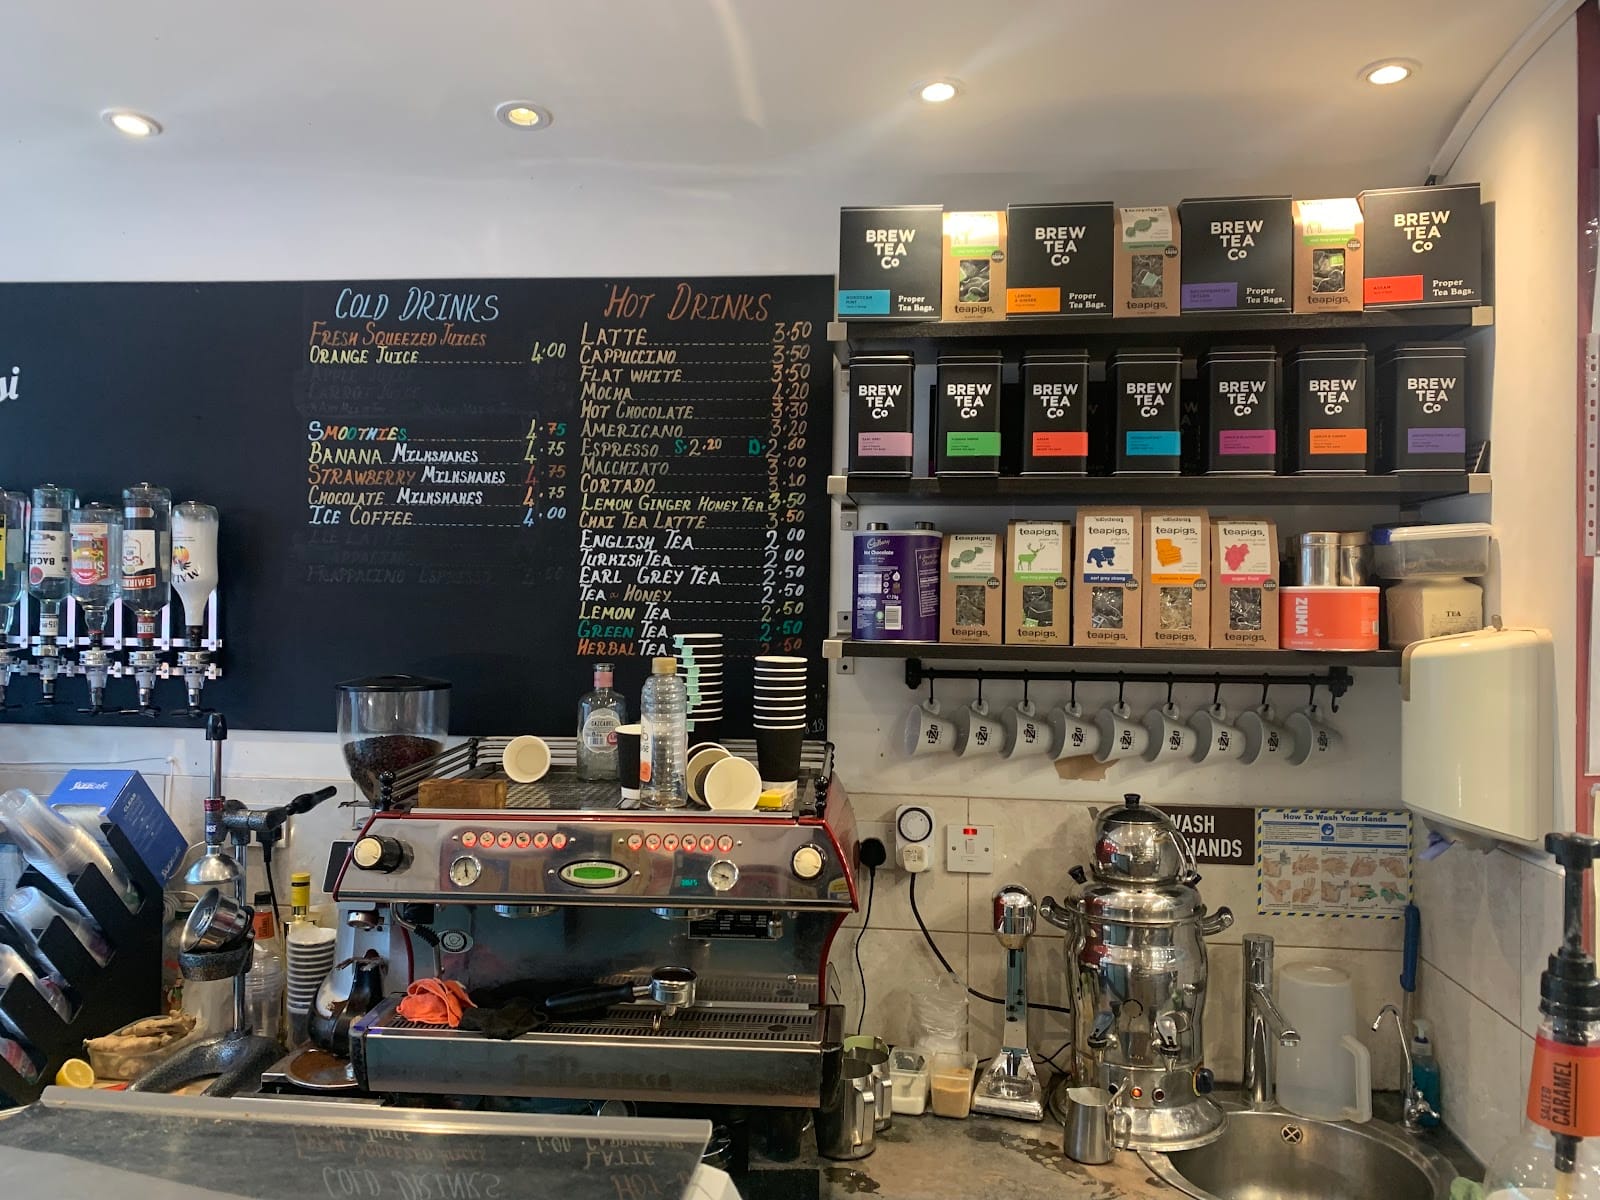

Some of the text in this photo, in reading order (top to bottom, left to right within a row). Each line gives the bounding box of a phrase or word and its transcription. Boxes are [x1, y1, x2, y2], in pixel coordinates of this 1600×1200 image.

[1394, 209, 1450, 227] BREW
[1034, 226, 1086, 240] BREW
[1211, 220, 1264, 235] BREW
[1404, 226, 1441, 240] TEA
[866, 229, 916, 243] BREW
[1220, 234, 1255, 247] TEA
[874, 243, 908, 256] TEA
[1044, 240, 1077, 253] TEA
[1412, 240, 1433, 253] Co
[1051, 254, 1070, 267] Co
[1228, 249, 1247, 261] Co
[881, 257, 900, 269] Co
[1432, 279, 1463, 288] Proper
[1068, 293, 1097, 302] Proper
[1246, 287, 1275, 296] Proper
[1432, 288, 1448, 296] Tea
[336, 286, 500, 322] COLD DRINKS
[603, 282, 772, 322] HOT DRINKS
[898, 295, 925, 304] Proper
[1068, 301, 1082, 309] Tea
[1246, 296, 1261, 304] Tea
[898, 304, 912, 312] Tea
[309, 321, 486, 347] FRESH SQUEEZED JUICES
[580, 321, 812, 346] LATTE 3.50
[310, 345, 369, 365] ORANGE
[376, 345, 419, 364] JUICE
[579, 344, 810, 365] CAPPUCCINO 3.50
[579, 363, 811, 383] FLAT WHITE 3.50
[858, 384, 903, 396] BREW
[947, 383, 992, 396] BREW
[1033, 384, 1079, 396] BREW
[1126, 382, 1173, 394] BREW
[1219, 381, 1266, 393] BREW
[1309, 379, 1357, 391] BREW
[1407, 377, 1457, 390] BREW
[580, 382, 633, 401] MOCHA
[1317, 391, 1350, 404] TEA
[1415, 390, 1449, 402] TEA
[866, 397, 895, 408] TEA
[954, 396, 985, 408] TEA
[1040, 395, 1071, 408] TEA
[1134, 394, 1165, 406] TEA
[1227, 393, 1259, 405] TEA
[580, 400, 610, 419] HOT
[616, 400, 695, 420] CHOCOLATE
[872, 408, 889, 419] Co
[960, 408, 978, 419] Co
[1047, 408, 1065, 419] Co
[1140, 407, 1158, 418] Co
[1234, 405, 1252, 417] Co
[1324, 403, 1343, 416] Co
[1422, 402, 1442, 414] Co
[307, 421, 408, 441] SMOOTHIES
[580, 418, 808, 439] AMERICANO 3.20
[308, 441, 383, 465] BANANA
[391, 443, 479, 463] MILKSHAKES
[580, 438, 659, 458] ESPRESSO
[580, 453, 807, 476] MACCHIATO 3.00
[308, 464, 416, 486] STRAWBERRY
[420, 466, 506, 485] MILKSHAKES
[580, 473, 656, 494] CORTADO
[308, 485, 385, 506] CHOCOLATE
[396, 487, 483, 505] MILKSHAKES
[581, 493, 633, 511] LEMON
[639, 494, 692, 512] GINGER
[697, 496, 739, 512] HONEY
[768, 492, 807, 511] 3.50
[308, 505, 341, 525] ICE
[350, 505, 413, 526] COFFEE
[579, 509, 805, 530] CHAI TEA LATTE 3.50
[580, 529, 656, 550] ENGLISH
[664, 528, 695, 550] TEA
[579, 548, 644, 568] TURKISH
[644, 549, 674, 567] TEA
[579, 565, 622, 584] EARL
[637, 566, 685, 585] GREY
[689, 566, 722, 585] TEA
[762, 564, 806, 586] 2.50
[579, 583, 805, 604] TEA HONEY 2.50
[578, 601, 804, 623] LEMON TEA 2.50
[1295, 597, 1308, 635] ZUMA
[577, 619, 803, 642] GREEN TEA 2.50
[577, 638, 636, 656] HERBAL
[638, 638, 668, 656] TEA
[1361, 815, 1388, 823] Hands
[206, 824, 217, 833] NSF
[1186, 838, 1243, 858] HANDS
[1552, 1061, 1572, 1127] CARAMEL
[1541, 1086, 1552, 1121] SALTED
